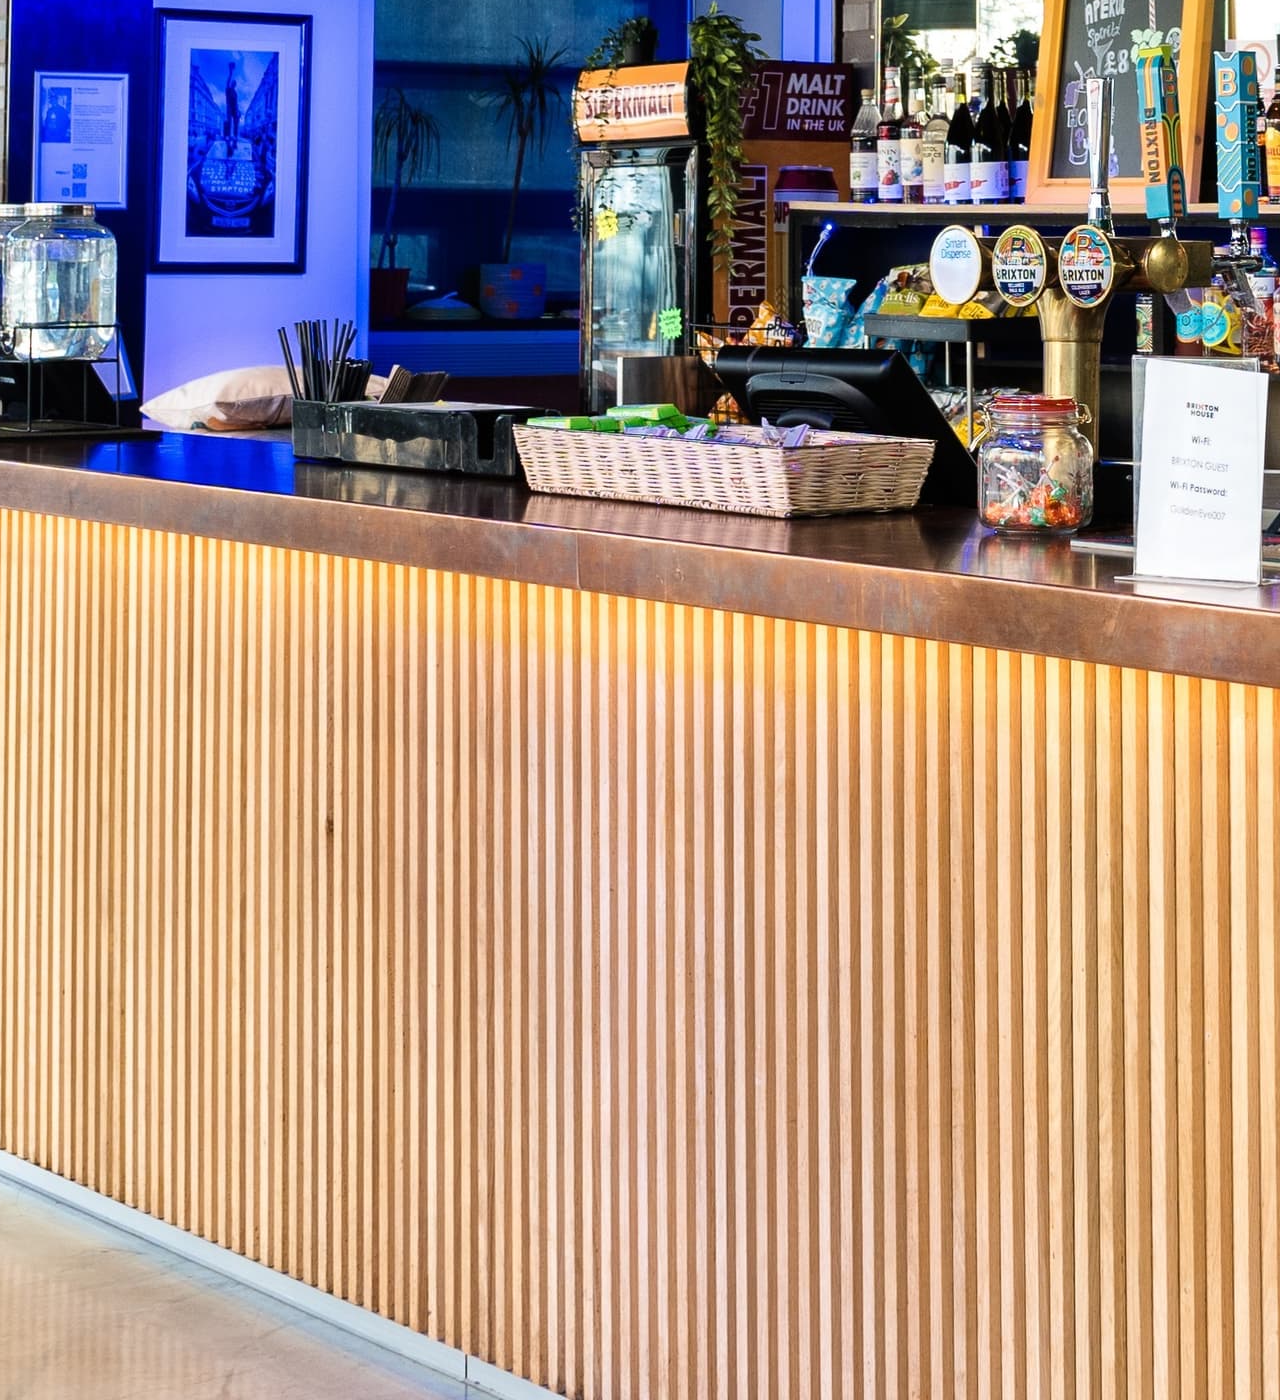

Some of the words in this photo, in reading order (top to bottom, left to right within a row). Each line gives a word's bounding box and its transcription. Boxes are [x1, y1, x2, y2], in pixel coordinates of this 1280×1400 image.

[1103, 49, 1129, 76] £8
[786, 72, 846, 96] MALT
[1217, 67, 1237, 98] B
[584, 84, 676, 119] SUPERMALT
[785, 97, 846, 117] DRINK
[786, 119, 801, 130] IN
[804, 119, 825, 131] THE
[827, 120, 846, 132] UK
[1144, 107, 1162, 184] BRIXTON
[1245, 103, 1258, 182] BRIXTON
[945, 238, 968, 249] Smart
[941, 249, 972, 261] Dispense
[996, 268, 1037, 281] BRIXTON
[1063, 269, 1105, 282] BRIXTON
[1186, 402, 1220, 412] BRIXTON
[1190, 410, 1215, 419] HOUSE
[1205, 461, 1229, 473] GUEST
[1169, 480, 1188, 491] Wi-Fi
